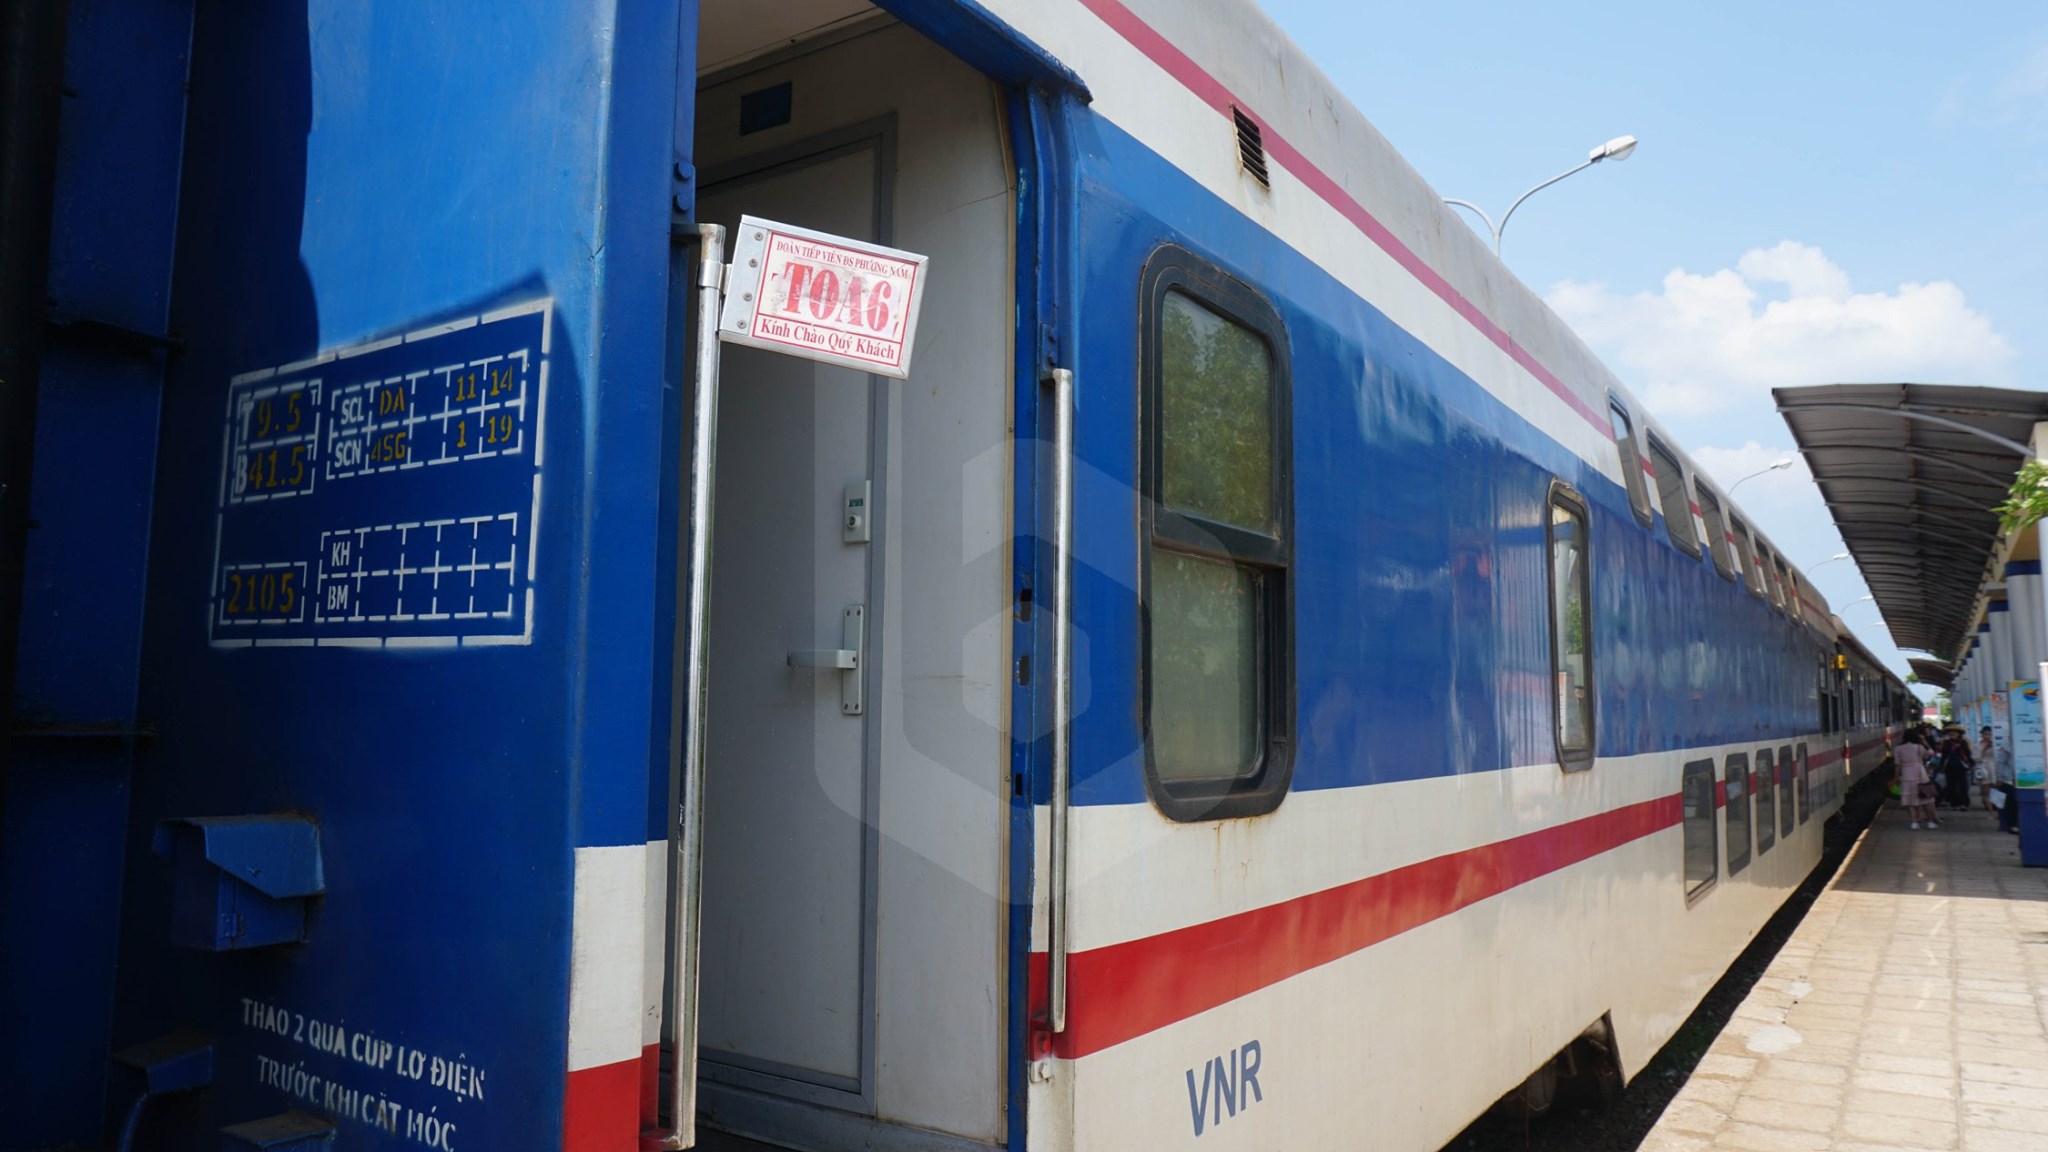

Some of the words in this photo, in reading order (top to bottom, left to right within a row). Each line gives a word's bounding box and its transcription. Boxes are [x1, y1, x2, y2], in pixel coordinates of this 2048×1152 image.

[843, 255, 854, 267] ĐS
[760, 318, 791, 338] Kính
[794, 325, 825, 345] Chào
[828, 332, 853, 354] Quý
[856, 338, 895, 360] Khách
[455, 372, 476, 402] 11
[489, 364, 513, 397] 14
[340, 395, 364, 425] SCL
[379, 386, 405, 416] DA
[456, 420, 466, 448] 1
[487, 414, 513, 444] 19
[334, 438, 362, 468] SCN
[235, 454, 248, 493] B
[330, 540, 351, 567] KH
[227, 571, 295, 613] 2105
[327, 584, 349, 611] BM
[293, 1013, 304, 1042] 2
[257, 1055, 320, 1104] TRƯỚC
[324, 1080, 358, 1119] KHI
[1186, 1039, 1263, 1137] VNR
